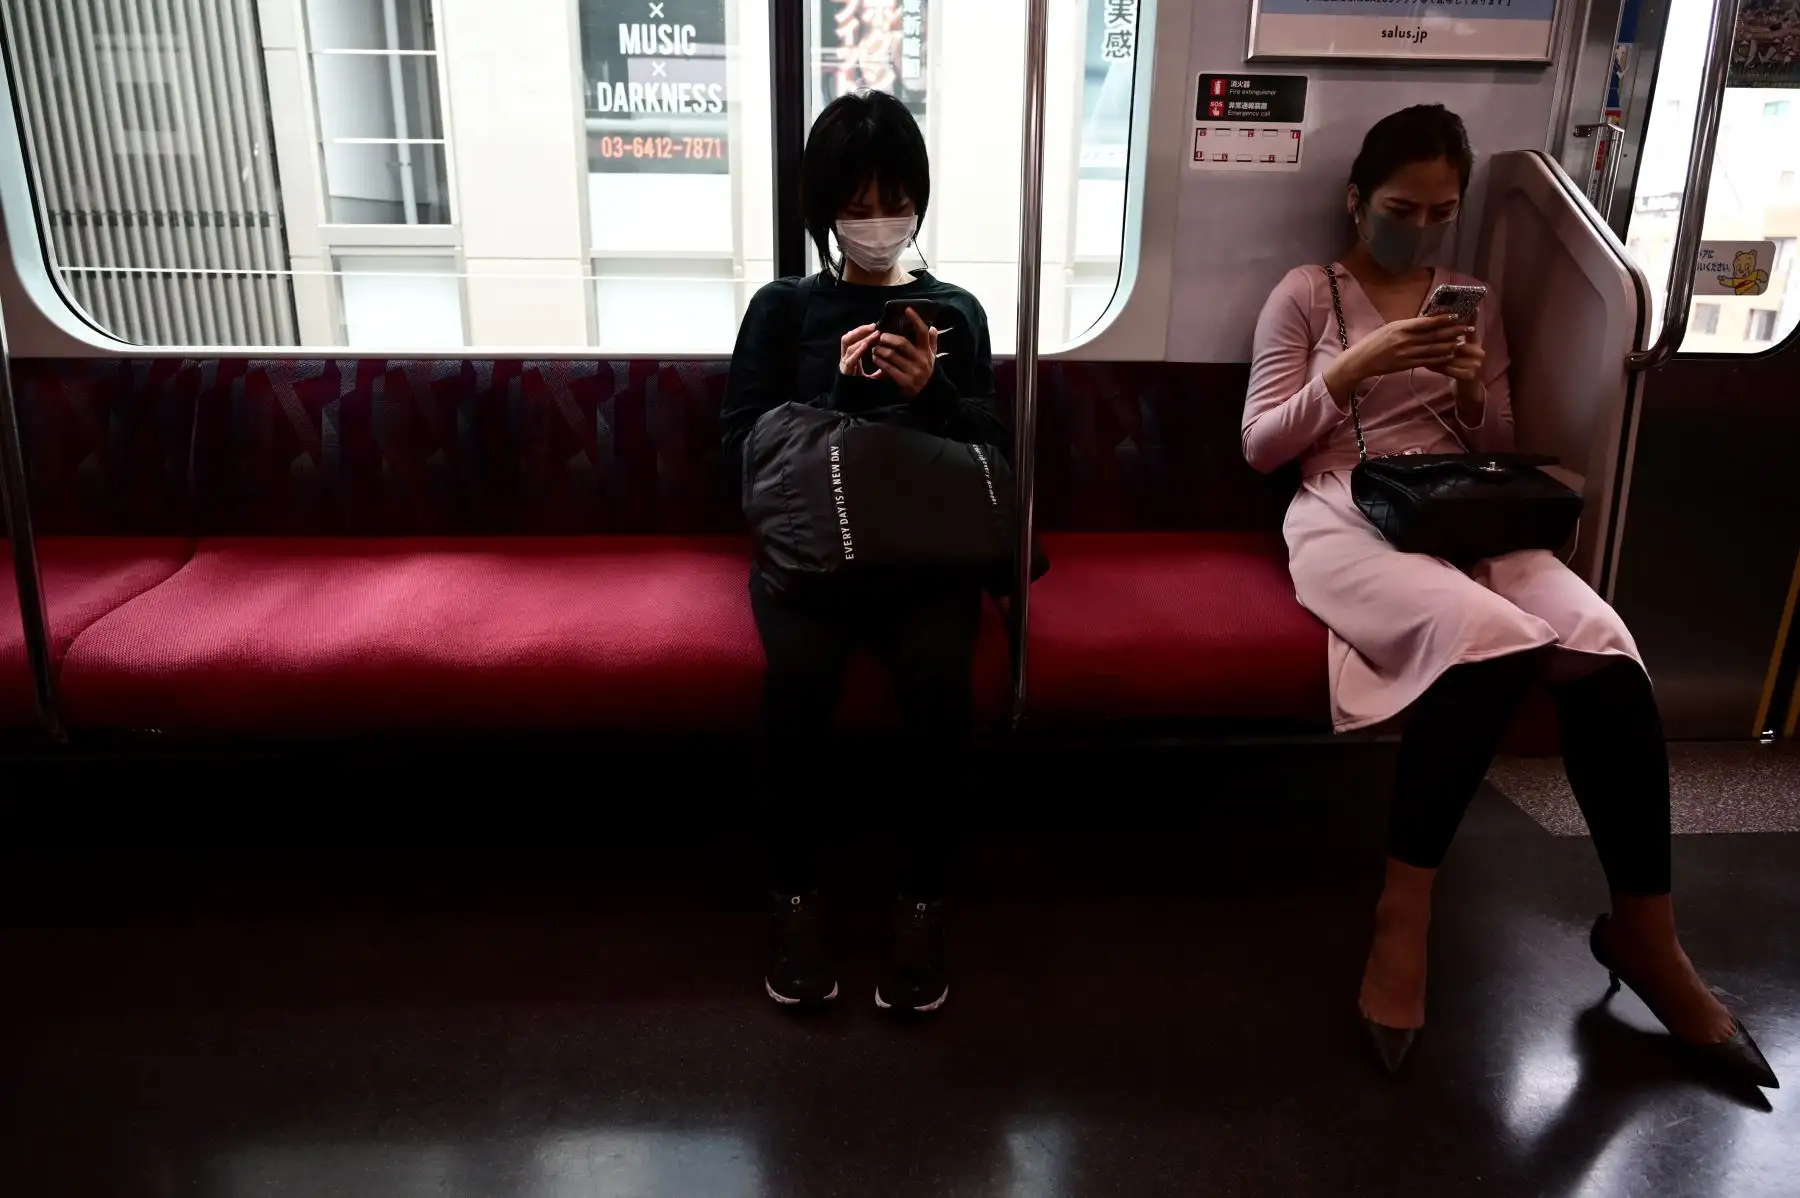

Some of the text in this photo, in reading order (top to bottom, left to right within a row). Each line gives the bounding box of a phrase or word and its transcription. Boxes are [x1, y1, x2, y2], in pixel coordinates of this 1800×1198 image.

[618, 23, 697, 56] MUSIC
[1381, 25, 1428, 43] salus.jp
[596, 82, 723, 114] DARKNESS
[1241, 88, 1277, 96] extinguisher
[601, 136, 721, 158] 03-6412-7871
[1699, 249, 1715, 259] アに
[830, 445, 840, 462] DAY
[831, 464, 842, 485] NEW
[835, 495, 845, 505] IS
[837, 506, 848, 525] DAY
[841, 527, 854, 560] EVERY
